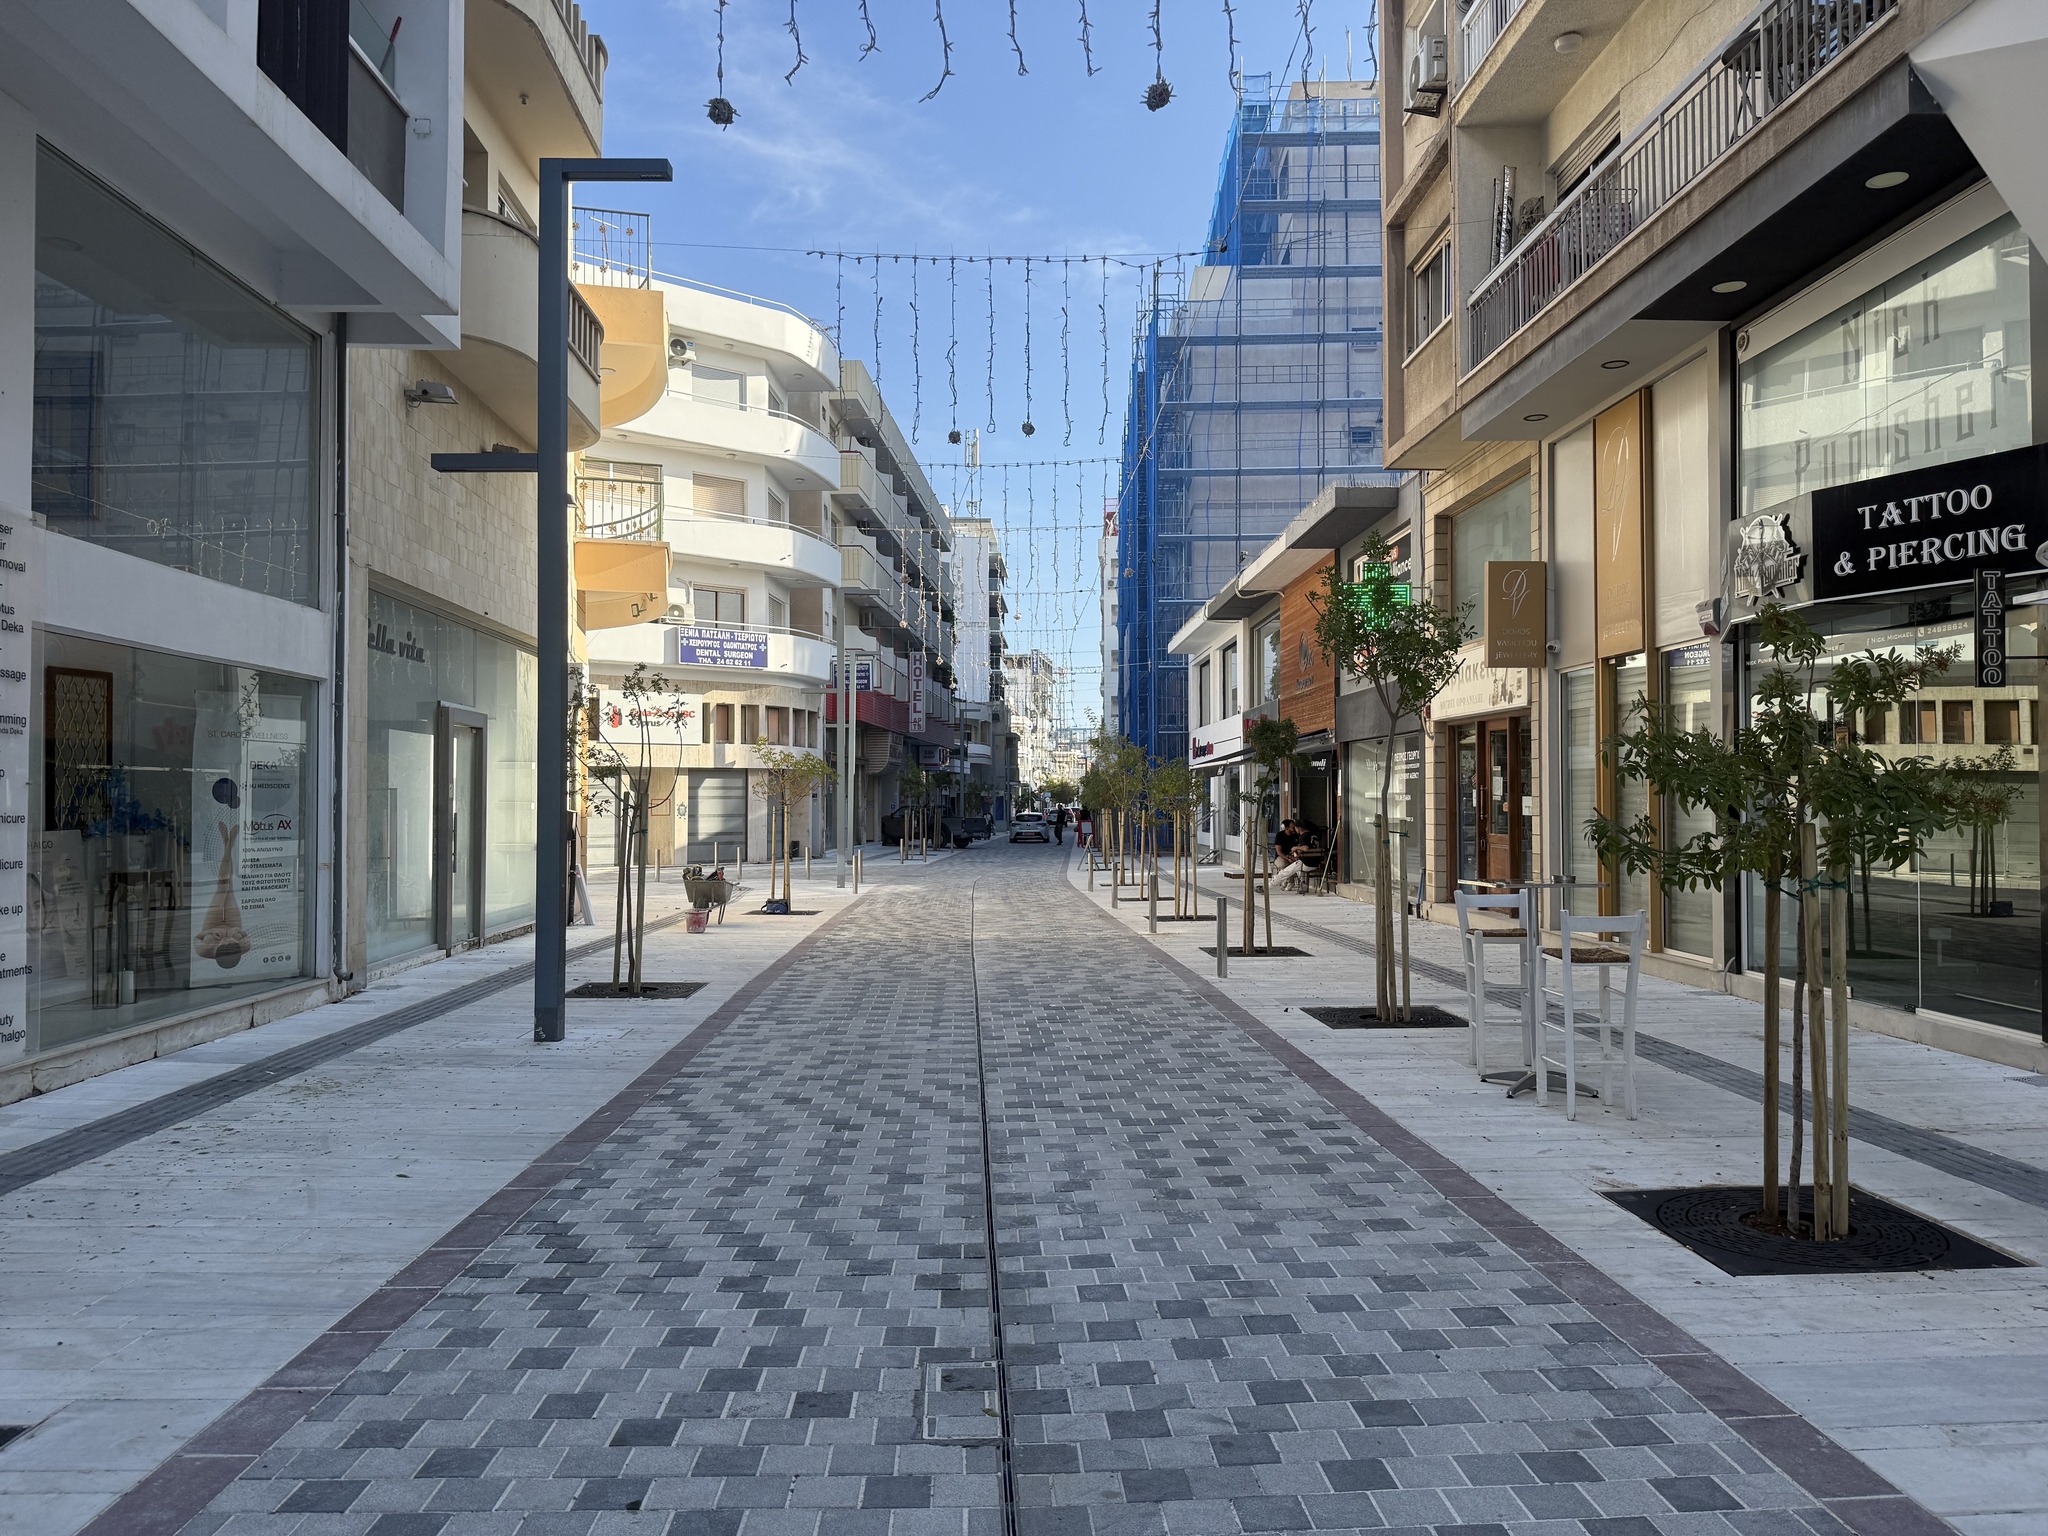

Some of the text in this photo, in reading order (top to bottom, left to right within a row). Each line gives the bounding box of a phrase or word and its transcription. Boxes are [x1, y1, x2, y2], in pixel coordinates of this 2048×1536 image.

[1857, 484, 1992, 530] TATTOO
[1833, 524, 2029, 577] & PIERCING
[0, 602, 15, 615] tus
[1, 620, 24, 634] Deka
[680, 627, 699, 638] ΞΕΝΙΑ
[1981, 570, 2003, 685] TATTOO
[368, 618, 426, 663] ella vita
[689, 639, 757, 651] ΧΕΙΡΟΥΡΓΟΣ ΟΔΟΝΤΙΑΤΡΟΣ
[696, 649, 753, 659] DENTAL SURGEON
[913, 654, 922, 714] HOTEL
[252, 732, 288, 740] WELLNESS
[250, 761, 278, 770] DEKA
[277, 819, 292, 831] AX
[12, 905, 23, 917] up
